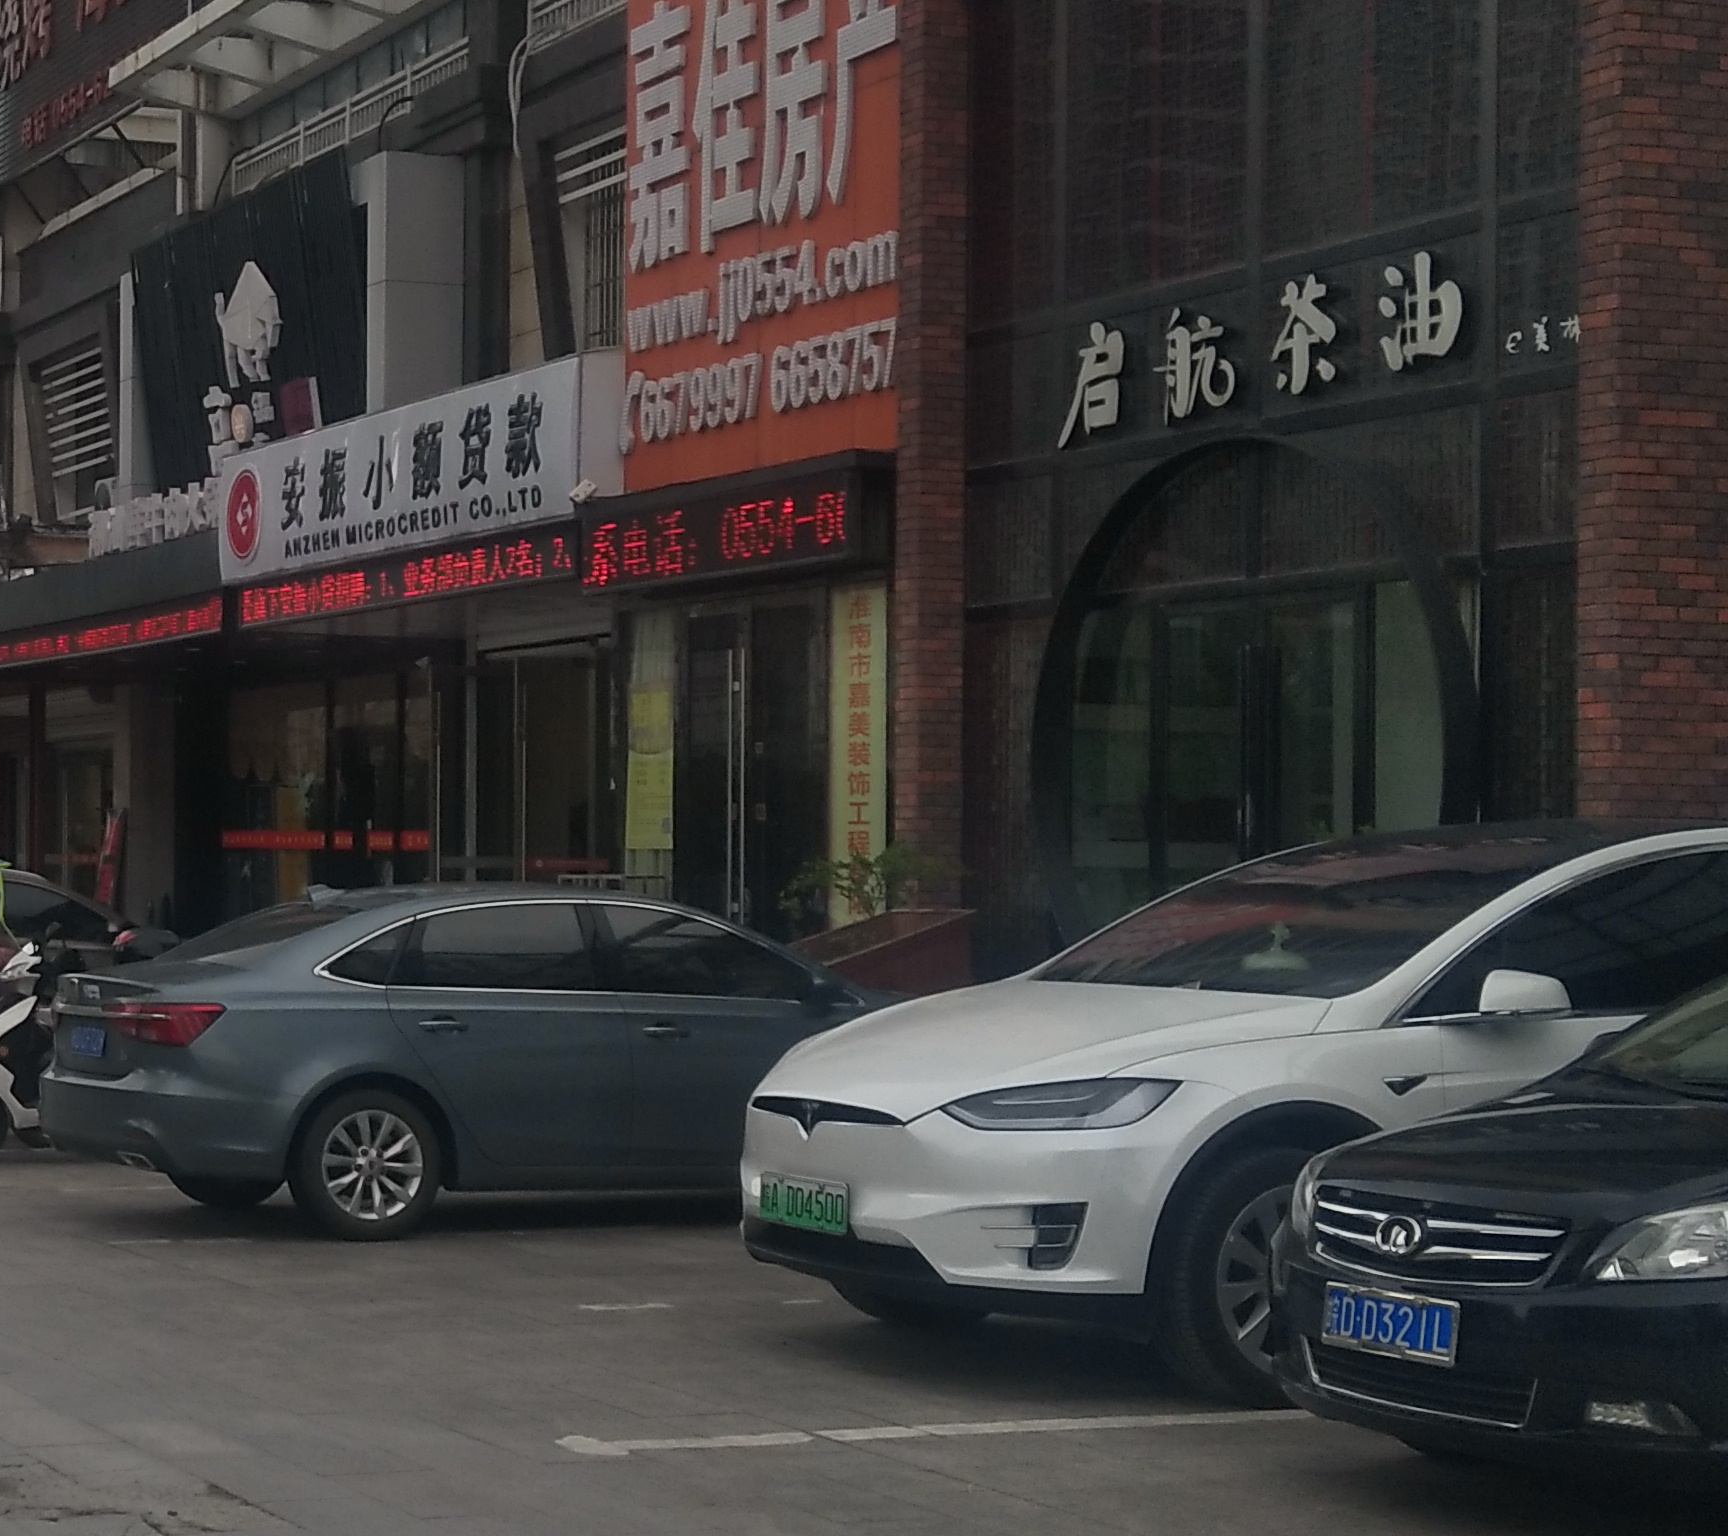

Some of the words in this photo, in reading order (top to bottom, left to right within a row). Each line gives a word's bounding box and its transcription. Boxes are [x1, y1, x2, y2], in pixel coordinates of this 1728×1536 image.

[627, 229, 900, 353] www.jj0554.com
[771, 316, 898, 413] 6658757
[1057, 250, 1463, 450] 启航茶油
[283, 522, 341, 559] ANZHEN
[345, 502, 459, 546] MICROCREDIT
